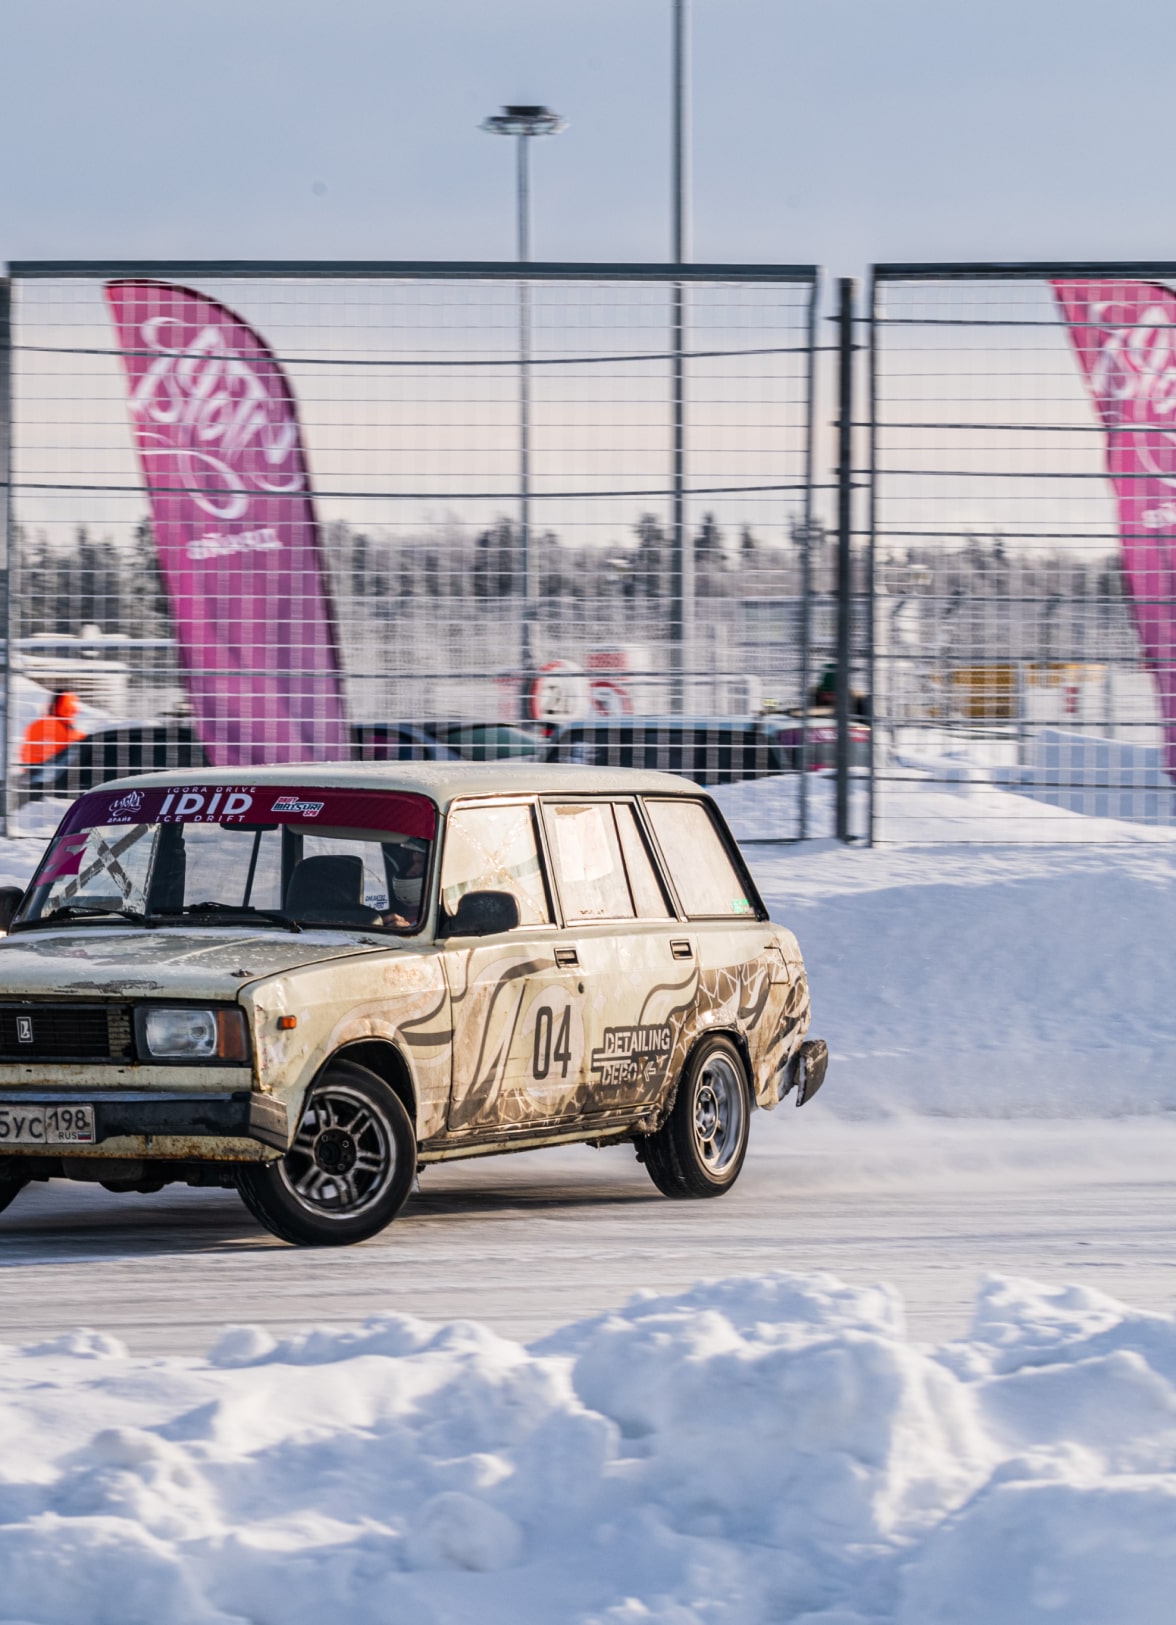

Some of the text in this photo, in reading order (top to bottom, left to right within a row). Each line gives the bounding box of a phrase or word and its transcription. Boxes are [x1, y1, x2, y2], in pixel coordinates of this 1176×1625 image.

[159, 793, 253, 815] IDID
[194, 815, 245, 823] DRIFT
[532, 1004, 571, 1080] 04
[605, 1028, 670, 1054] DETAILING
[48, 1109, 87, 1131] 198
[58, 1132, 77, 1140] RUS
